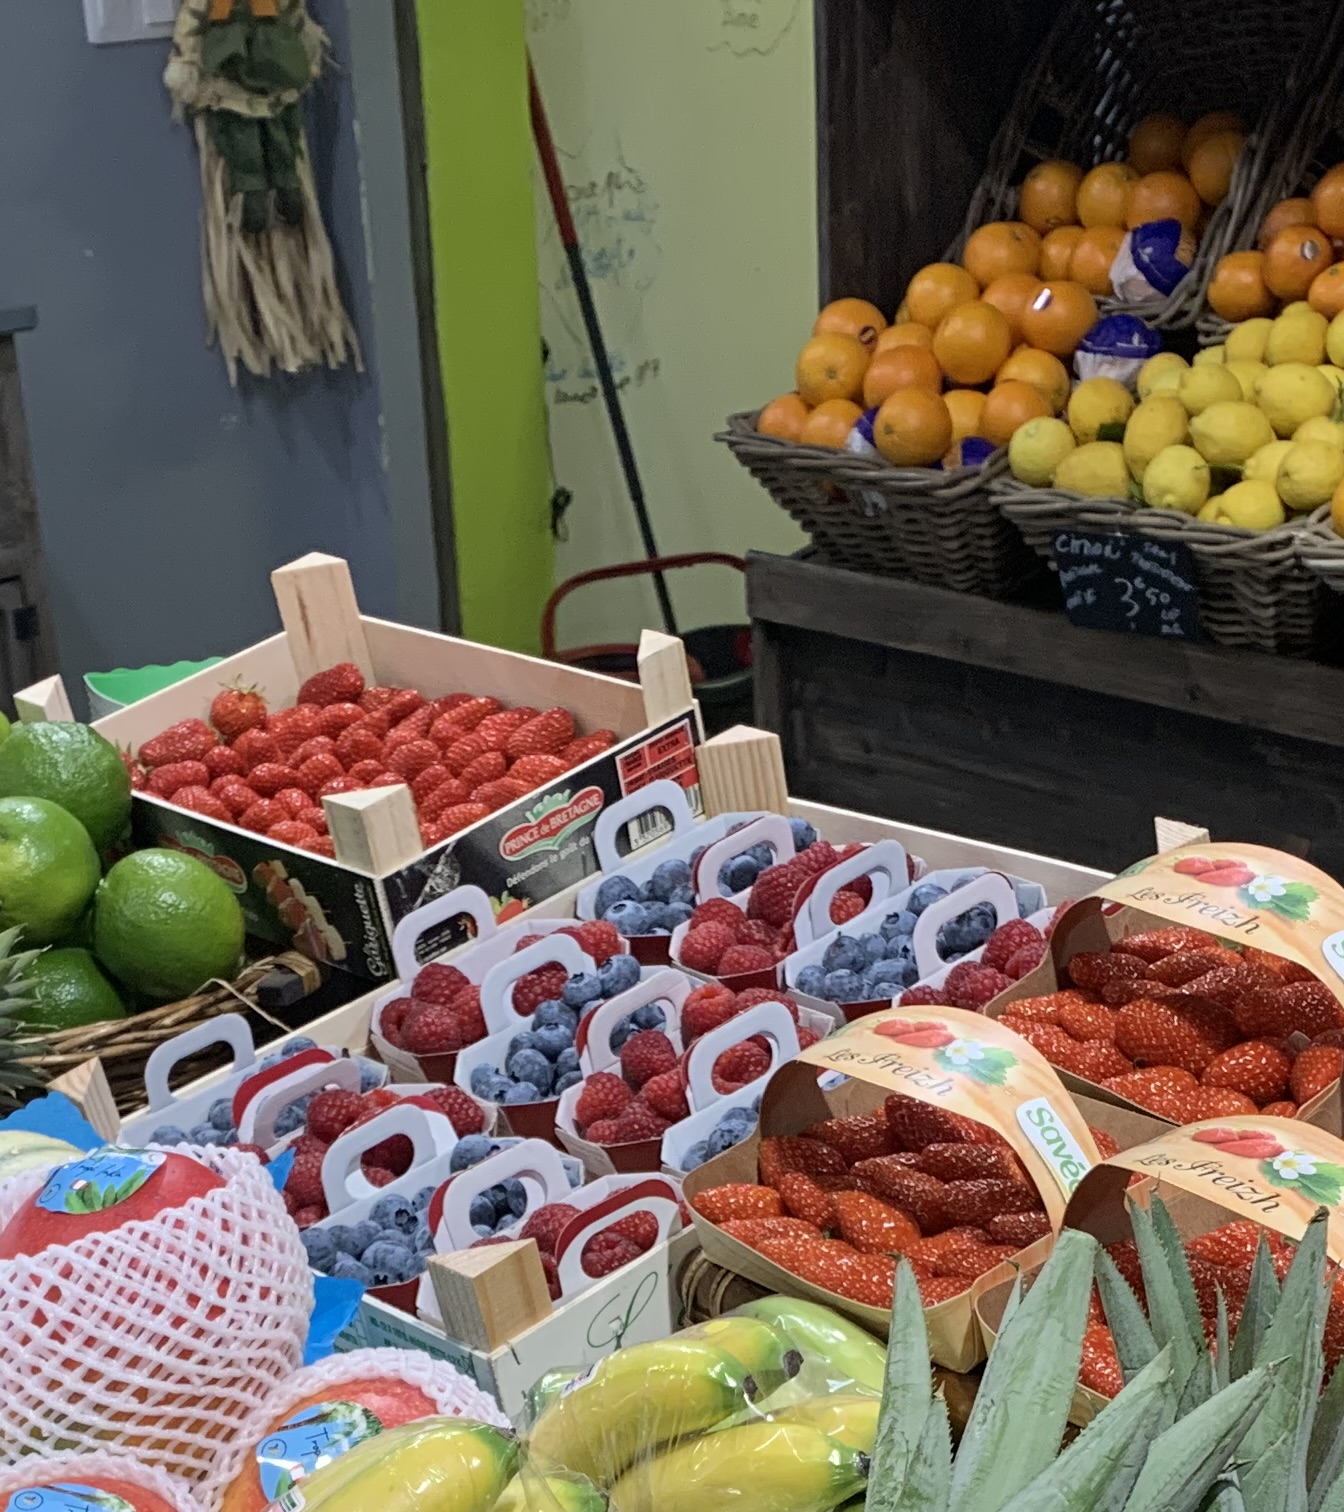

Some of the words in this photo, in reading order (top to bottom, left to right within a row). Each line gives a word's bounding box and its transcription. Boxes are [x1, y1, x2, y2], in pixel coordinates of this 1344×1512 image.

[504, 826, 539, 855] PRINCE
[540, 824, 550, 836] de
[549, 793, 600, 830] BRETAGNE
[506, 859, 549, 888] Défendons
[1126, 886, 1165, 905] Les
[1165, 889, 1262, 936] Freizh
[824, 1047, 861, 1063] Les
[860, 1050, 954, 1097] Freizh
[1136, 1152, 1174, 1167] Les
[1175, 1158, 1281, 1213] Freizh
